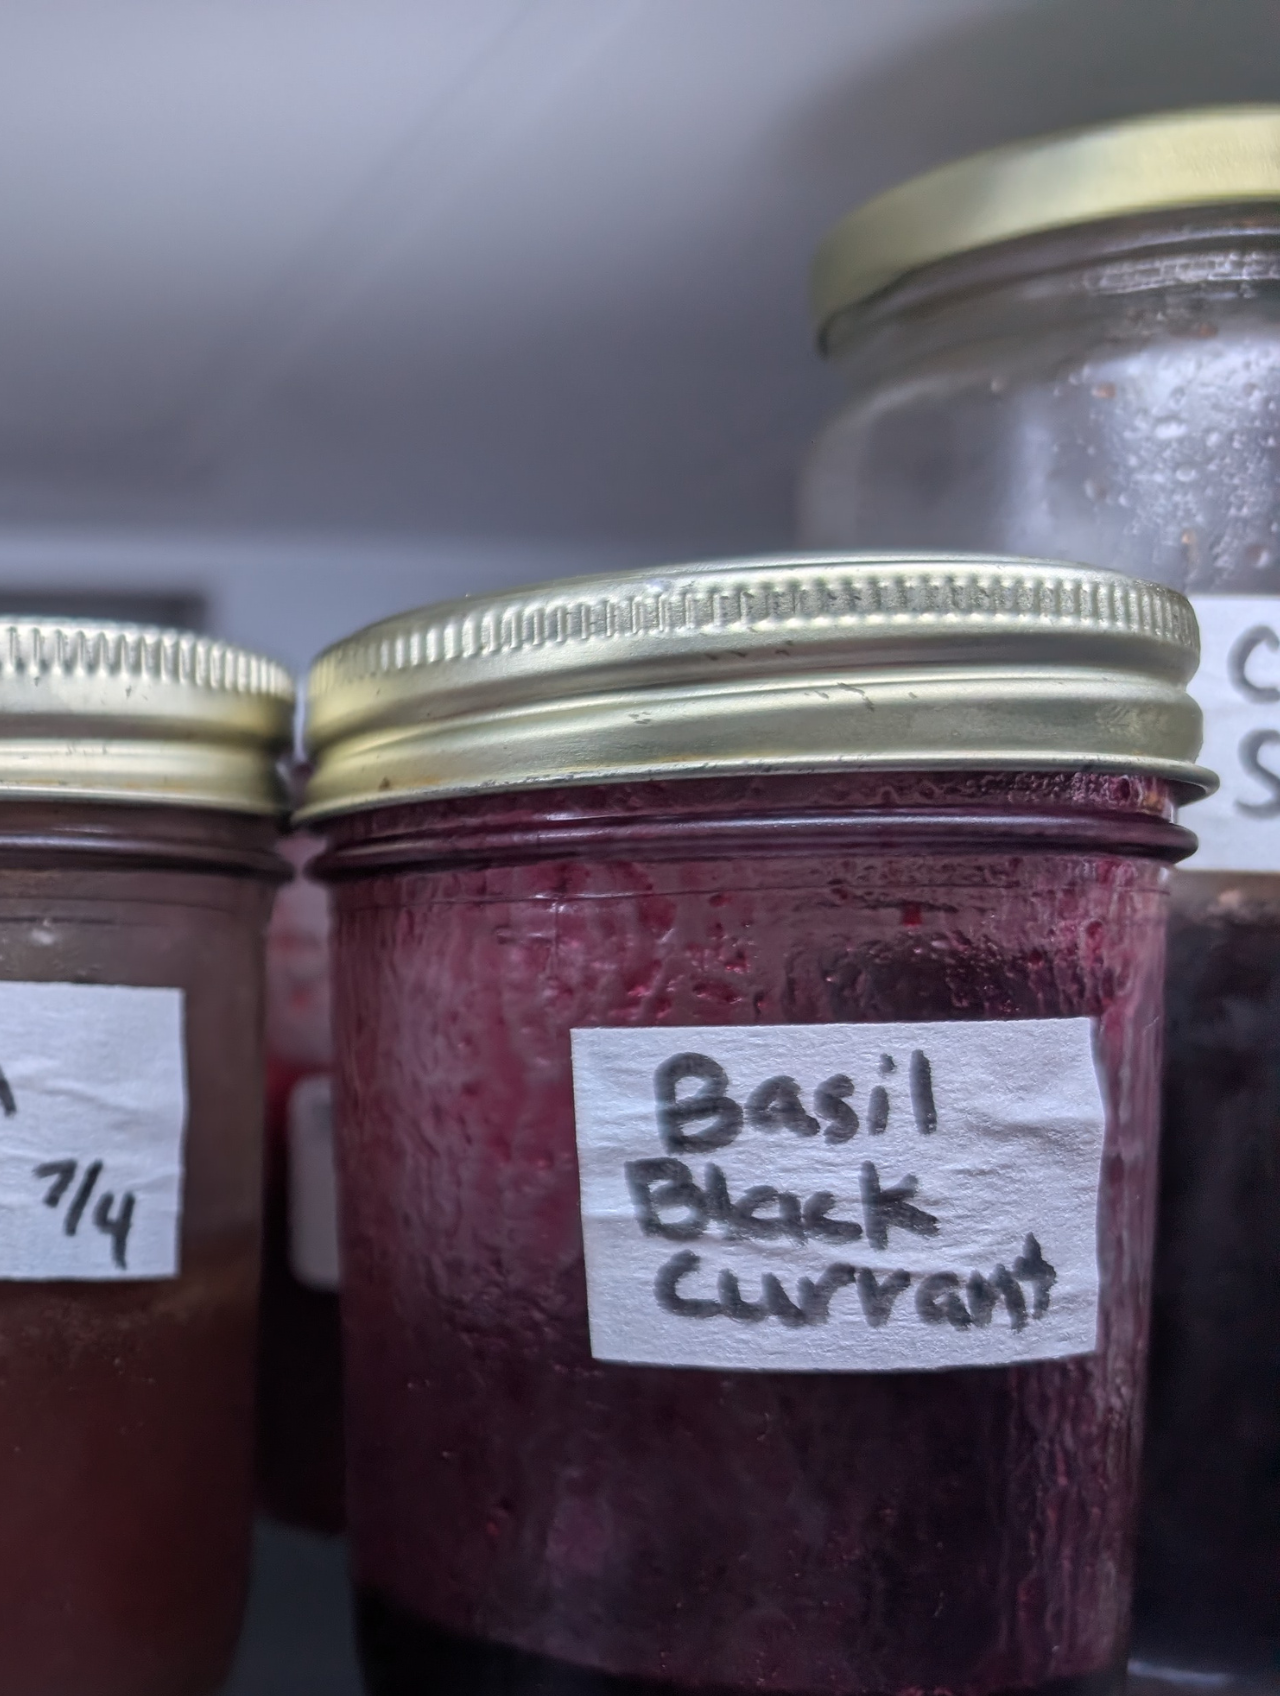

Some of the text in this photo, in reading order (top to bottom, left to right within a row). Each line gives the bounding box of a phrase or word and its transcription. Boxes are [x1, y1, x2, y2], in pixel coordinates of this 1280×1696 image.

[653, 1049, 938, 1154] Basil
[33, 1160, 136, 1270] 7/4
[623, 1157, 941, 1250] Black
